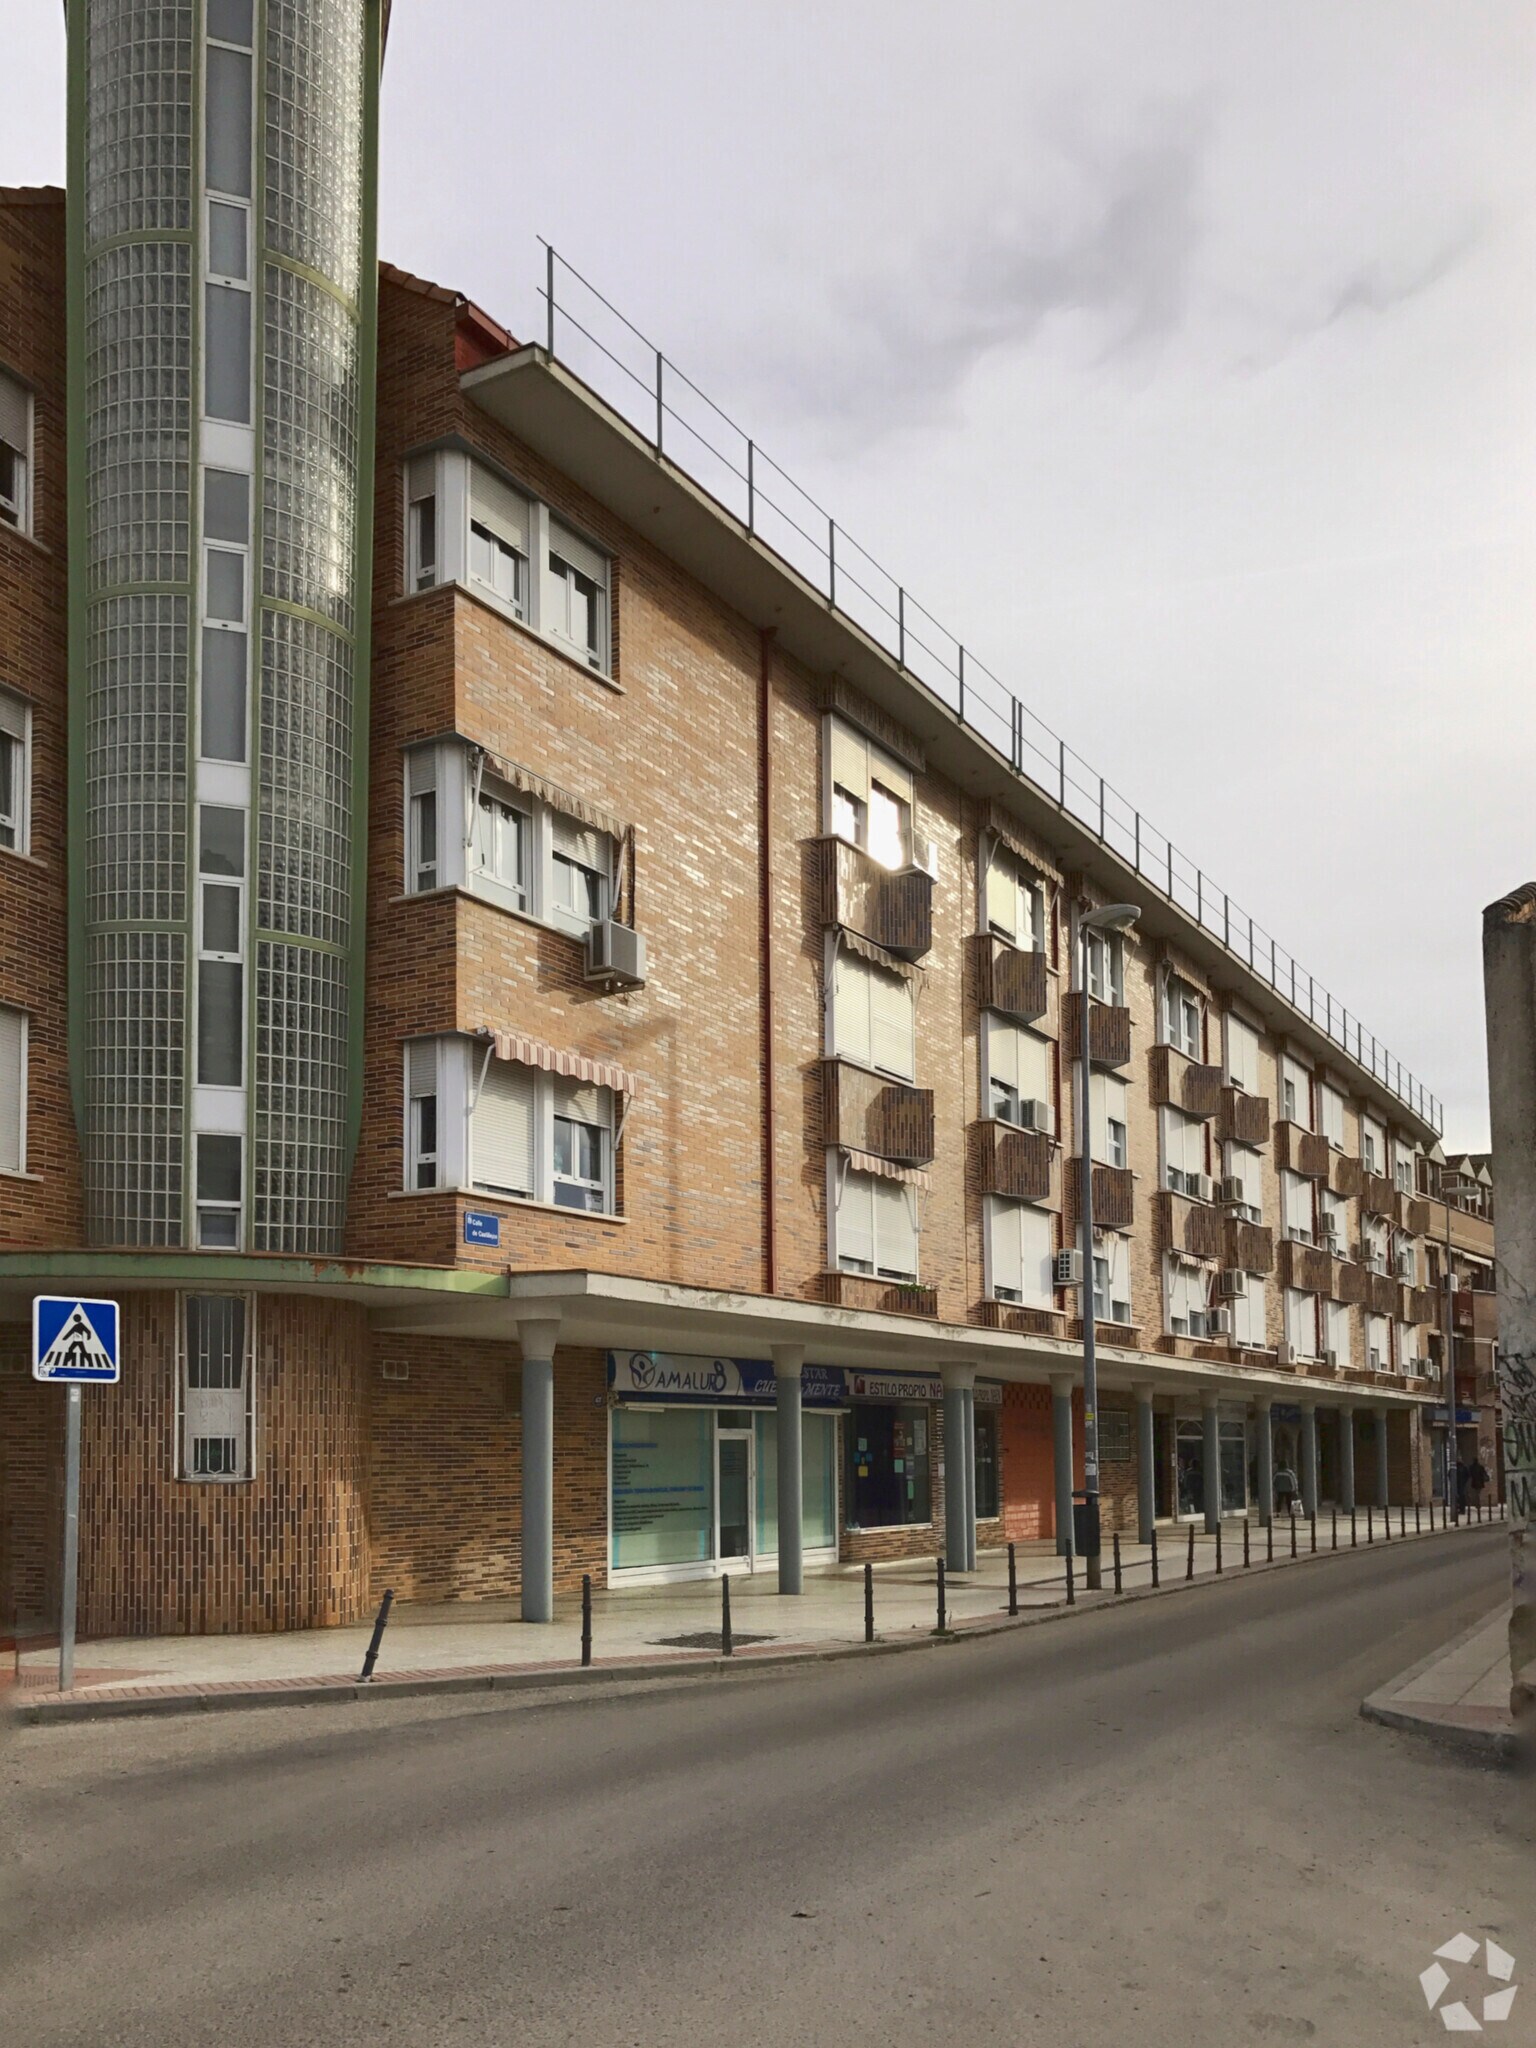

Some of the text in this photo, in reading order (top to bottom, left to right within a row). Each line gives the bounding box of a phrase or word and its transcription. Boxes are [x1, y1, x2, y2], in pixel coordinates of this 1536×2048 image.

[754, 1379, 841, 1396] CUE MENTE
[869, 1381, 943, 1398] ESTILO PROPIO NA
